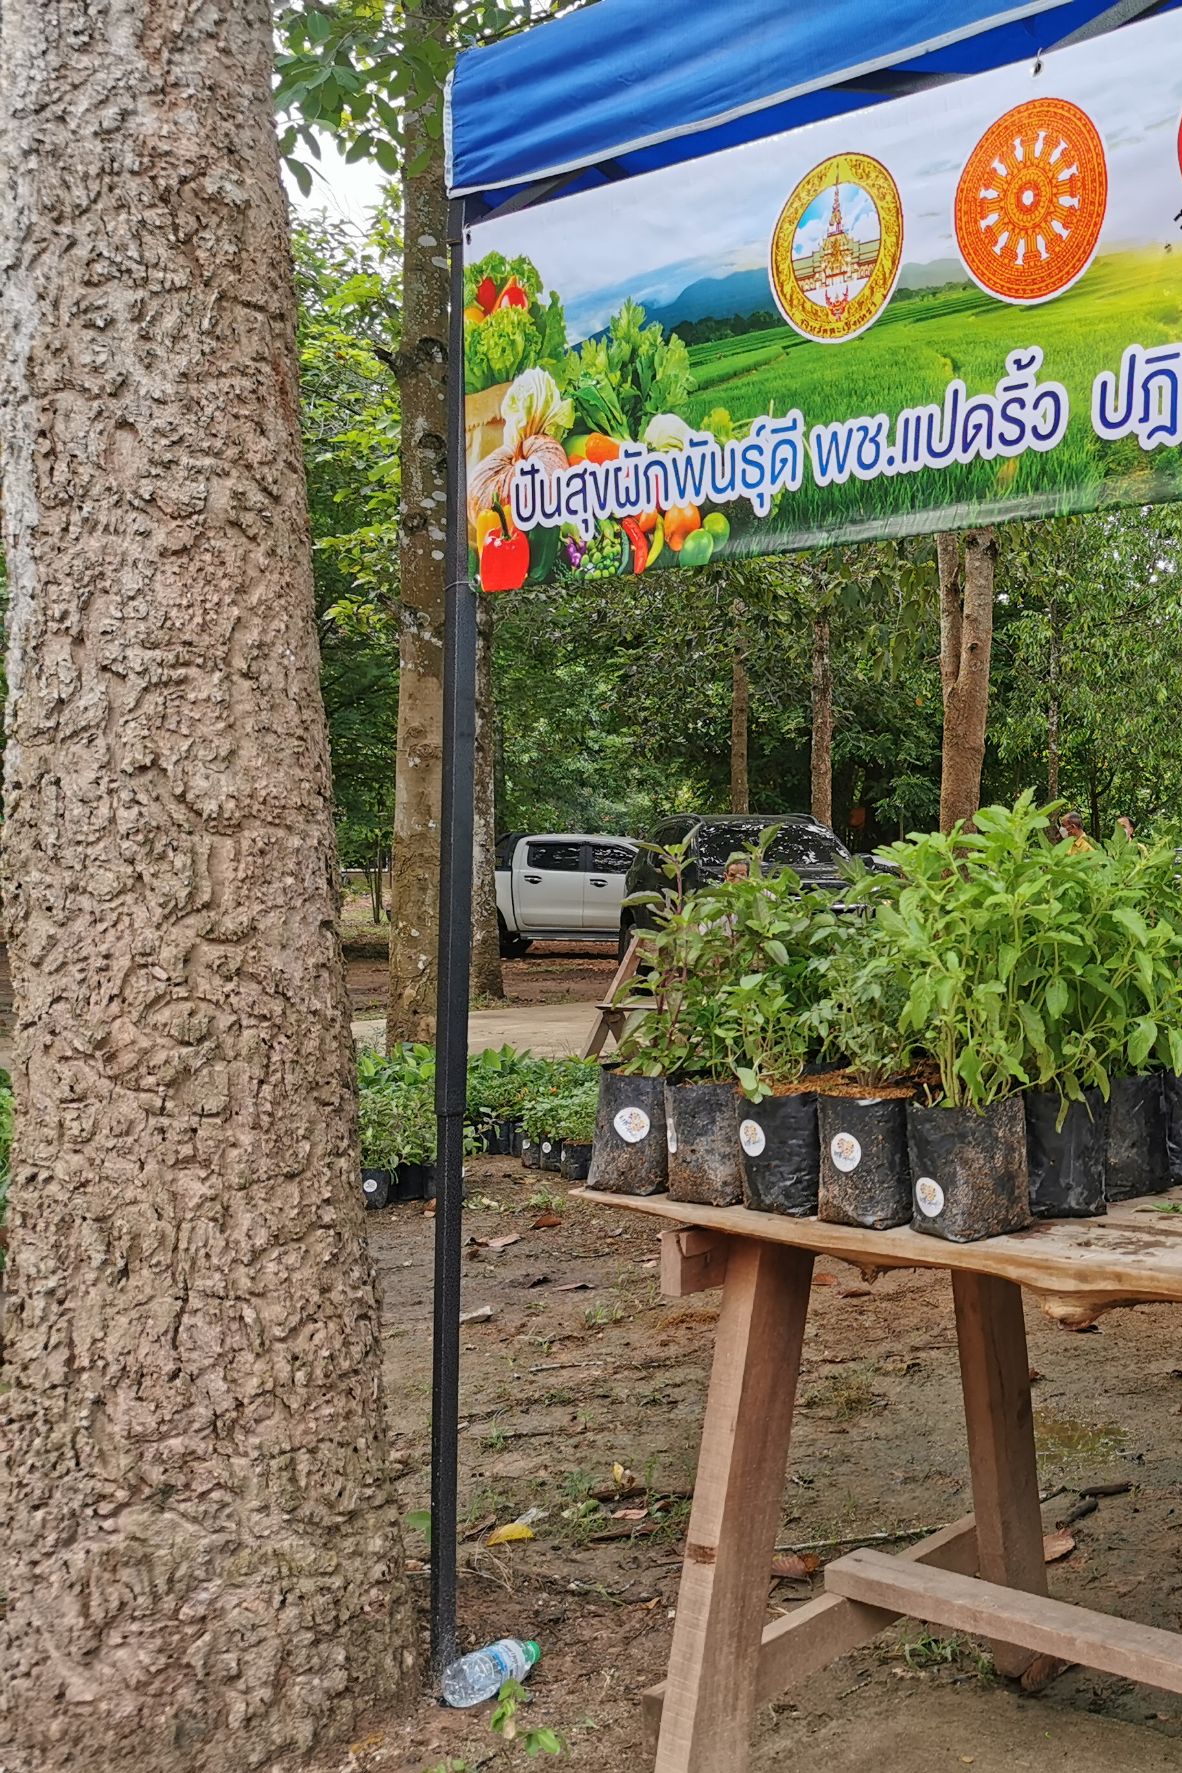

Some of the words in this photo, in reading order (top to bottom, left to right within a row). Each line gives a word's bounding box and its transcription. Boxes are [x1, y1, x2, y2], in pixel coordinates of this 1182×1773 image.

[513, 416, 799, 533] ปันสุขผักพันธุ์ดี
[815, 354, 1062, 478] พช.แปดริ้ว
